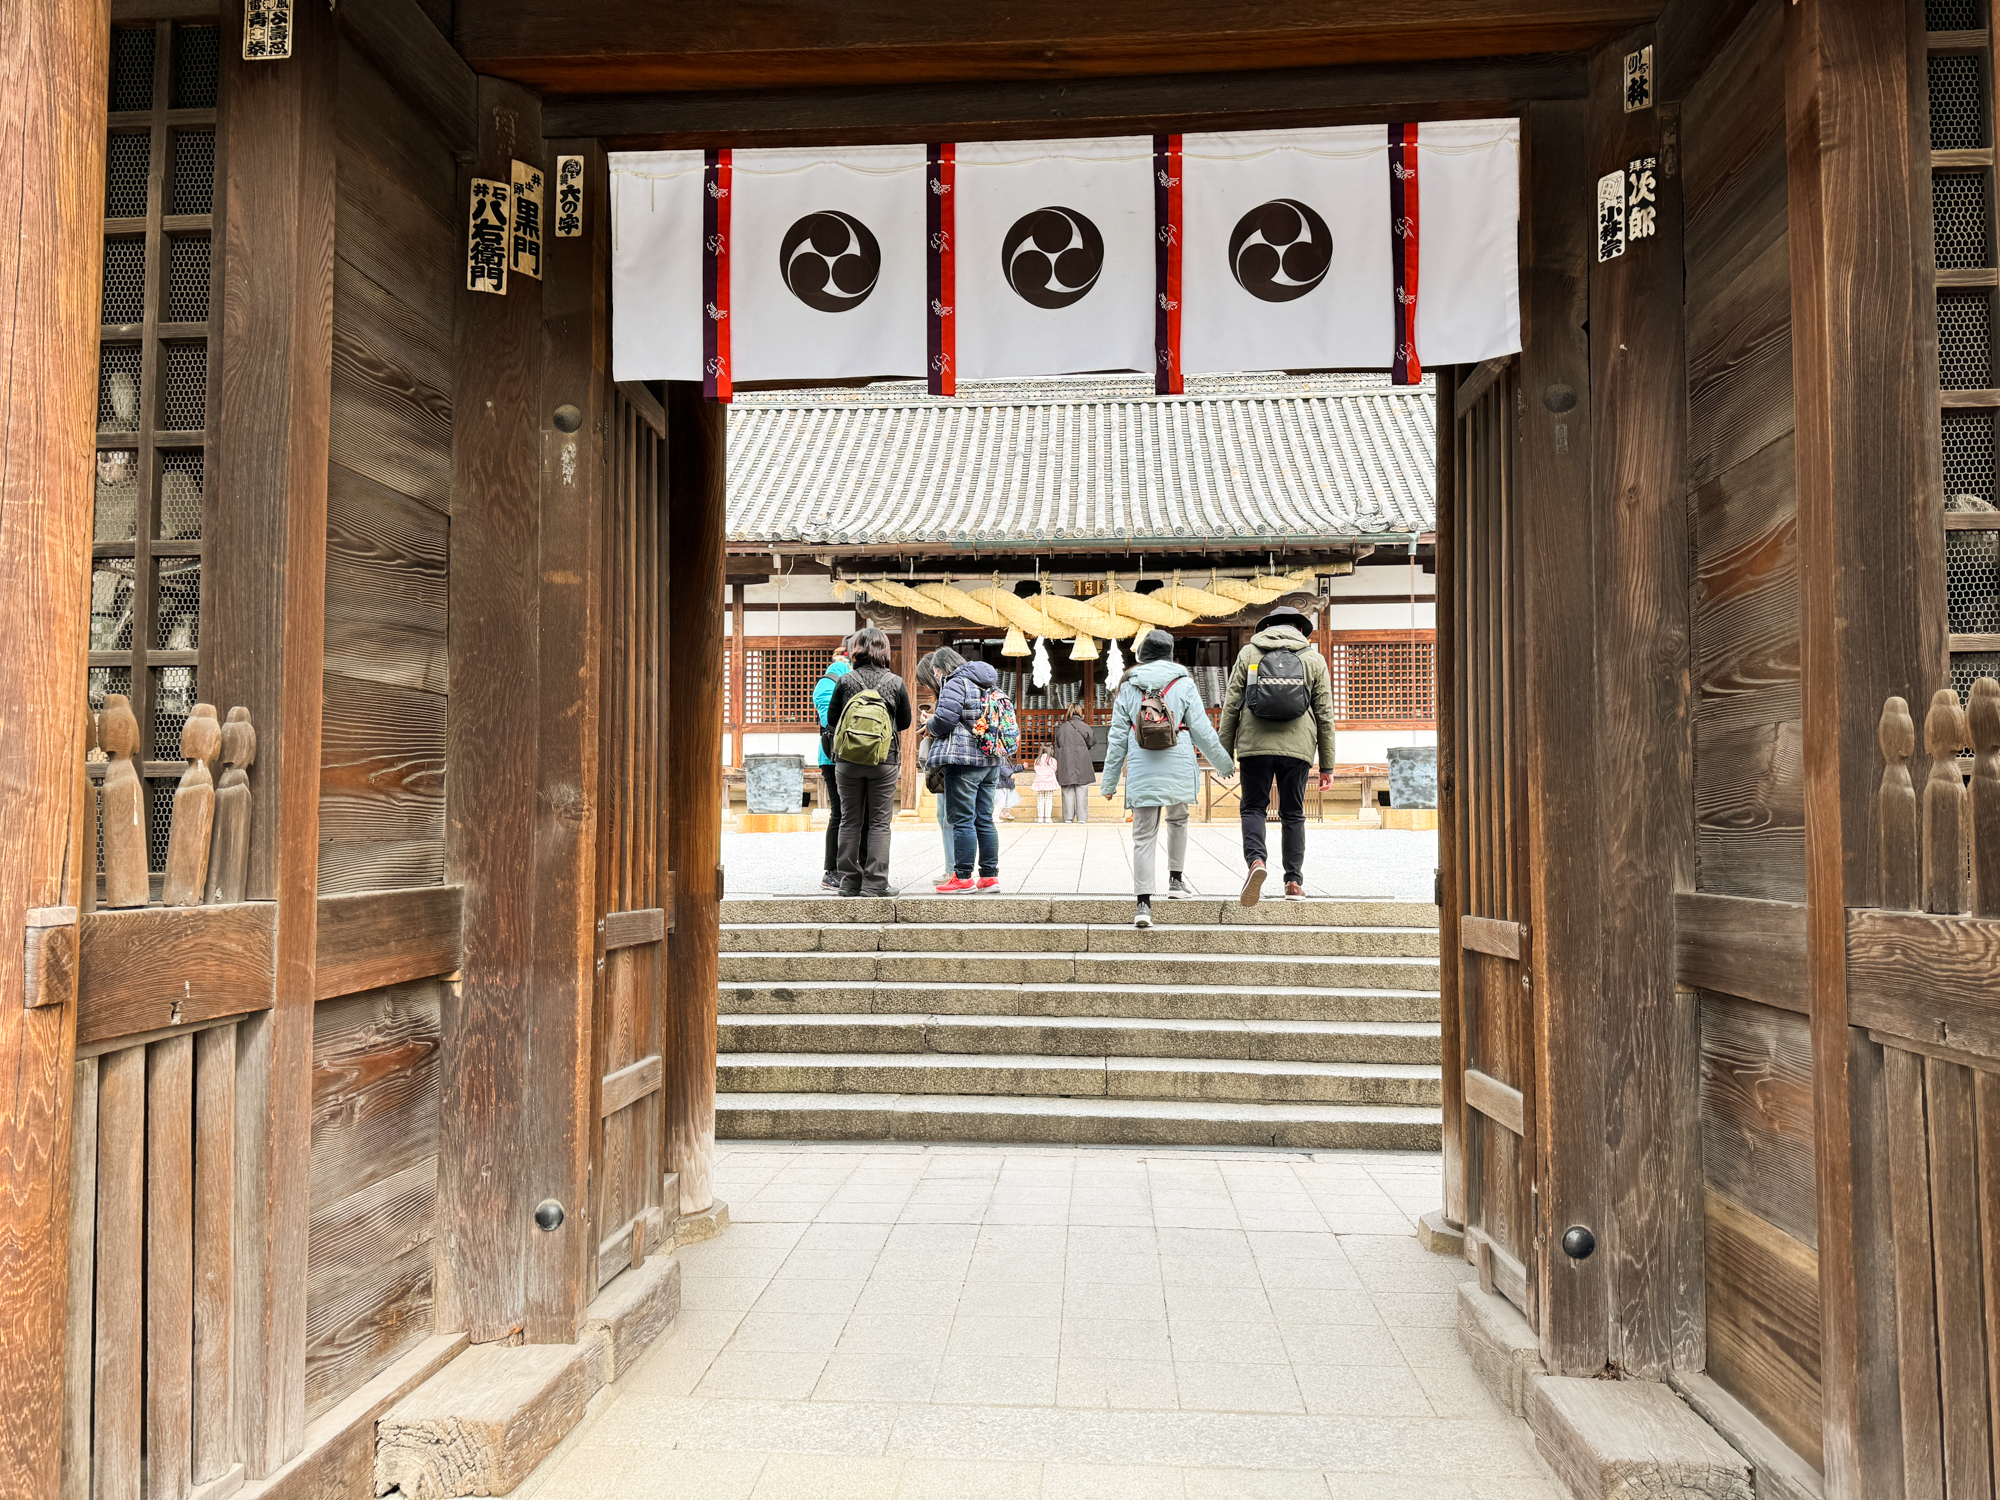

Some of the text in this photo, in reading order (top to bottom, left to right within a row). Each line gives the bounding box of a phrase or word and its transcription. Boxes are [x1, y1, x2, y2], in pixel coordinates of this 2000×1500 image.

[558, 185, 582, 235] 六の字
[1628, 170, 1657, 241] 次郎
[470, 198, 507, 291] 八右衛門
